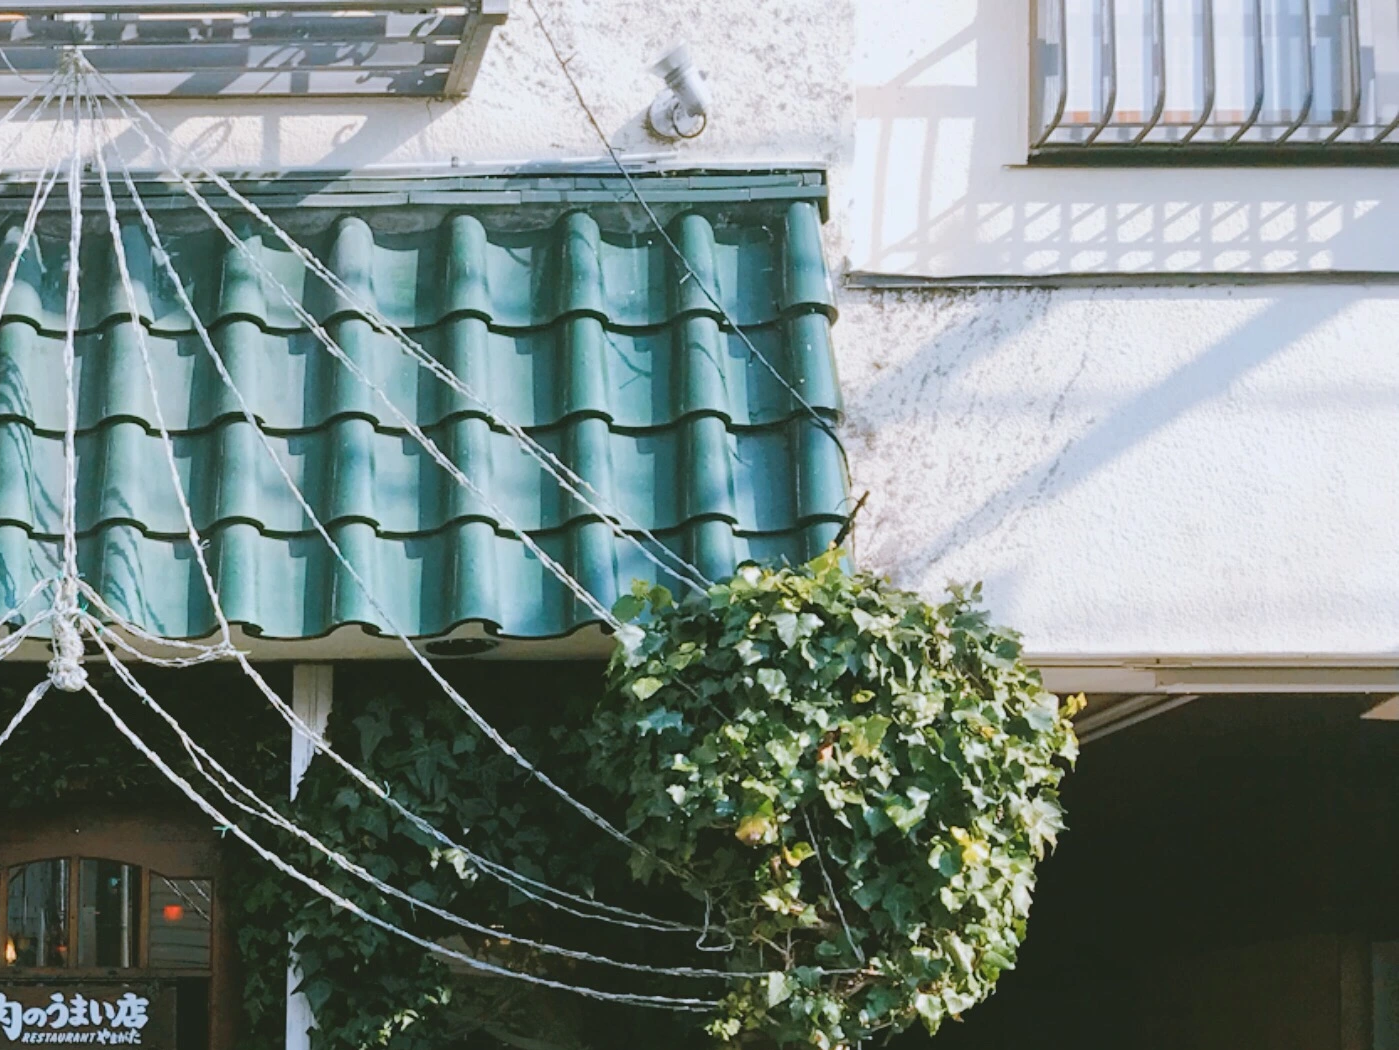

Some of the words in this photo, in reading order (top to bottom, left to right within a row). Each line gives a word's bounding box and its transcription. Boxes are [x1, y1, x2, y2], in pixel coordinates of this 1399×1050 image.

[21, 1032, 98, 1044] RESTAURANT
[96, 1027, 142, 1045] やまがた
